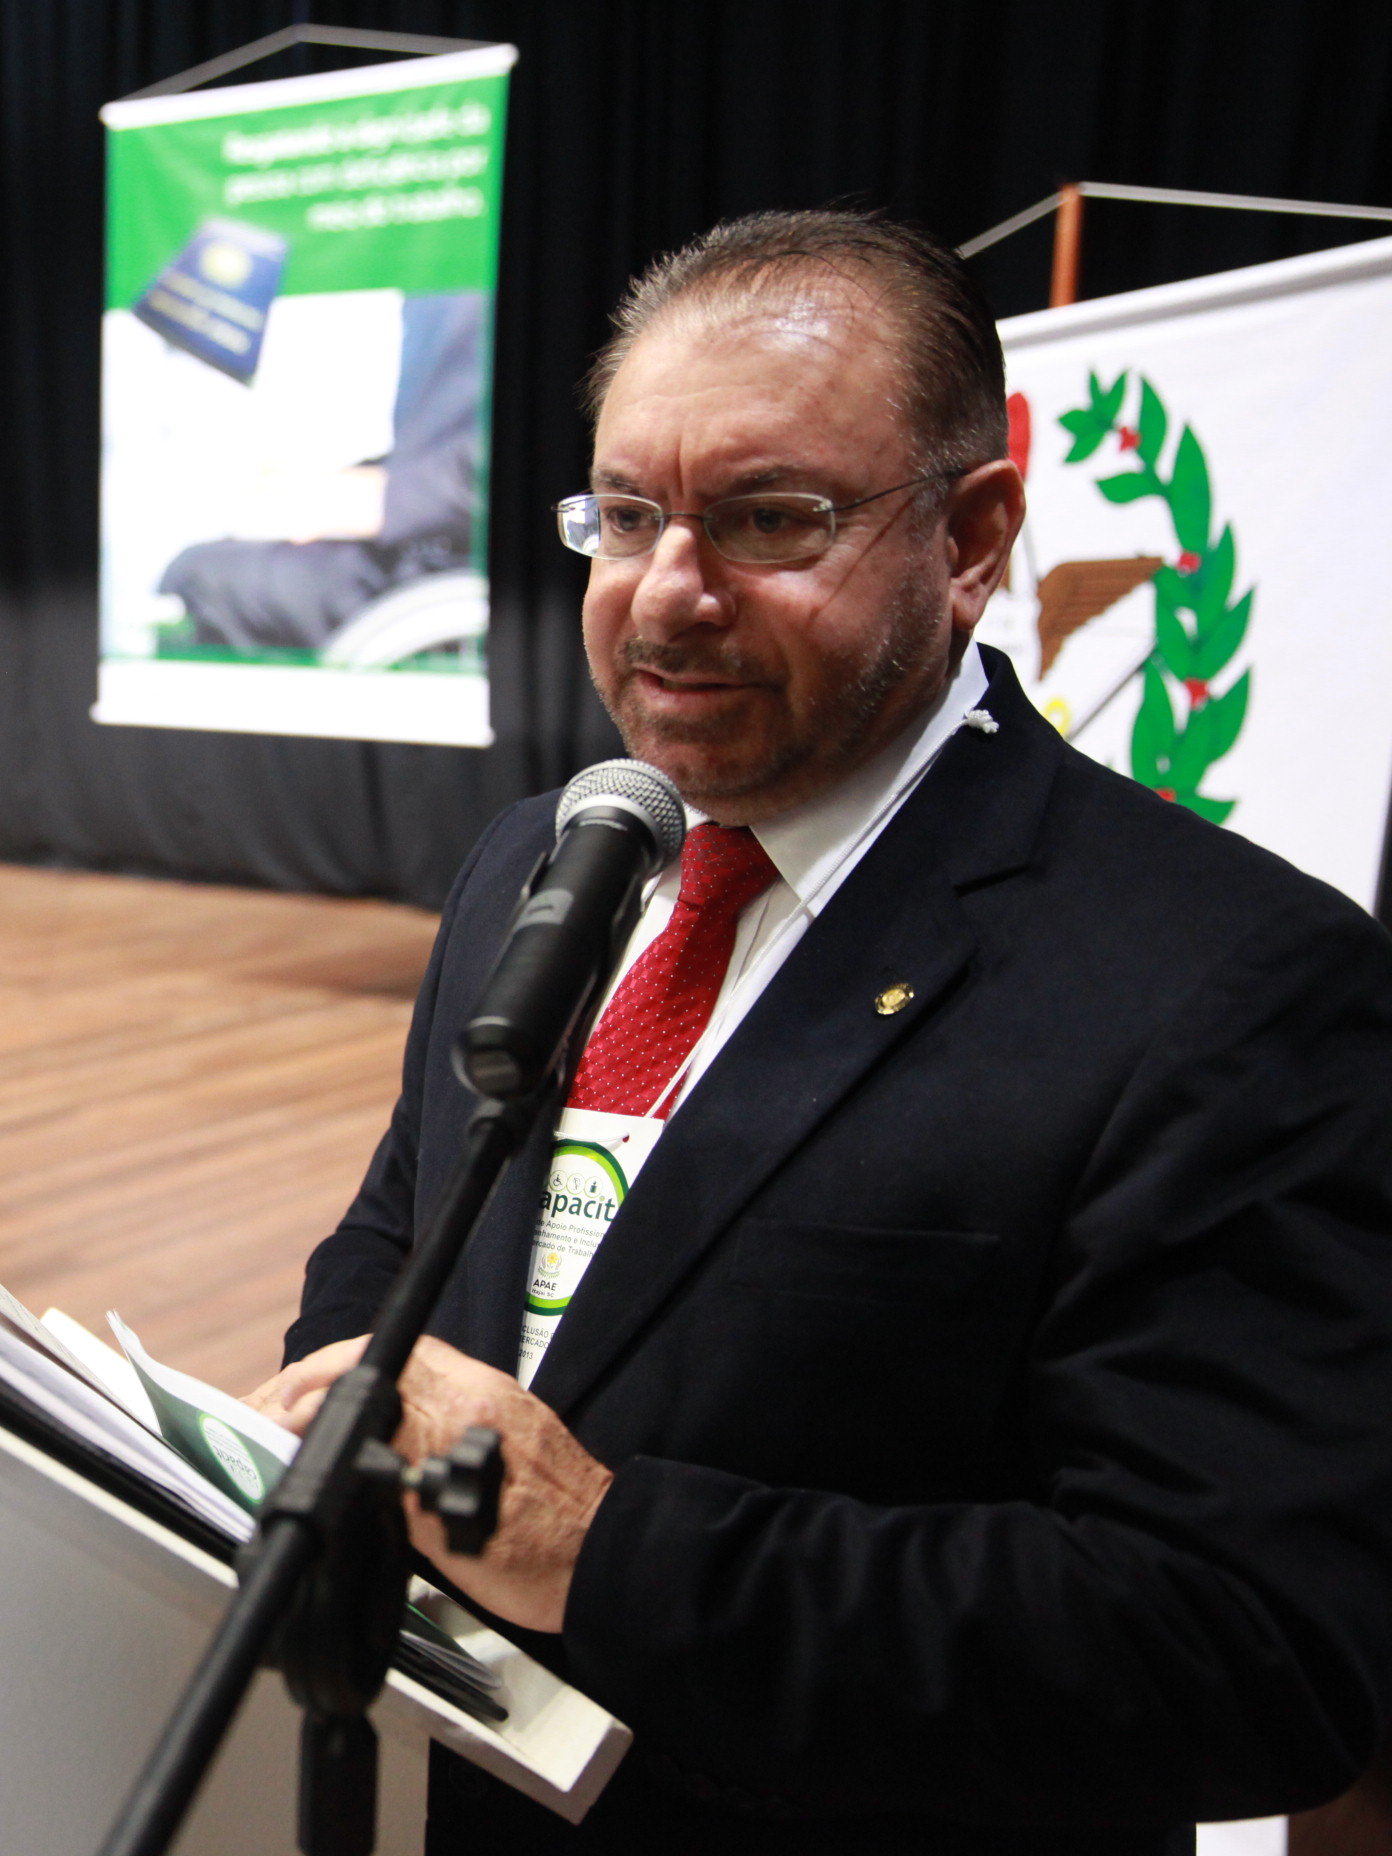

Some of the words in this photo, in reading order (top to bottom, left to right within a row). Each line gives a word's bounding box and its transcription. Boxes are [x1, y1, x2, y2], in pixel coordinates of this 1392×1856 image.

[546, 1220, 567, 1231] Apoio
[557, 1244, 566, 1253] de
[533, 1279, 557, 1291] APAE
[519, 1350, 533, 1359] 2013
